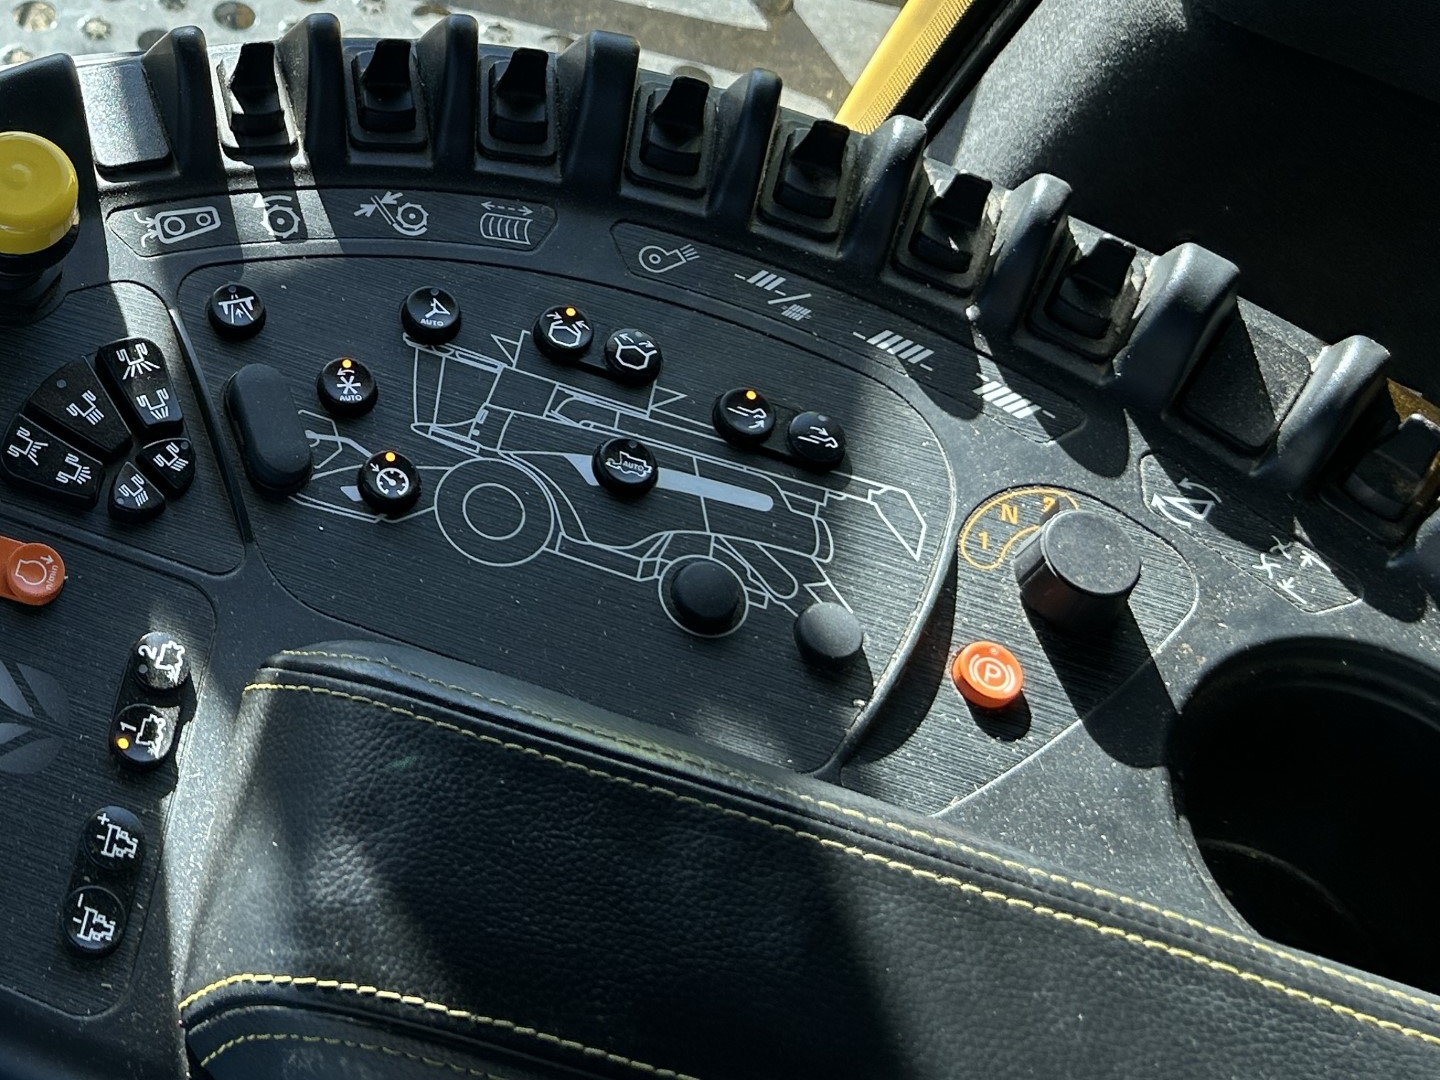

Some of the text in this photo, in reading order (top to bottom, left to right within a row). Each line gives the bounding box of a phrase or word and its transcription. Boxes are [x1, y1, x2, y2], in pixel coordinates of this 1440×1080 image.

[420, 318, 444, 327] AUTO
[339, 394, 363, 402] AUTO
[622, 460, 645, 472] AUTO
[978, 530, 990, 550] 1
[1001, 503, 1019, 525] N
[45, 564, 59, 591] n/min
[138, 644, 158, 660] 2
[984, 663, 1002, 682] P
[120, 721, 137, 732] 1
